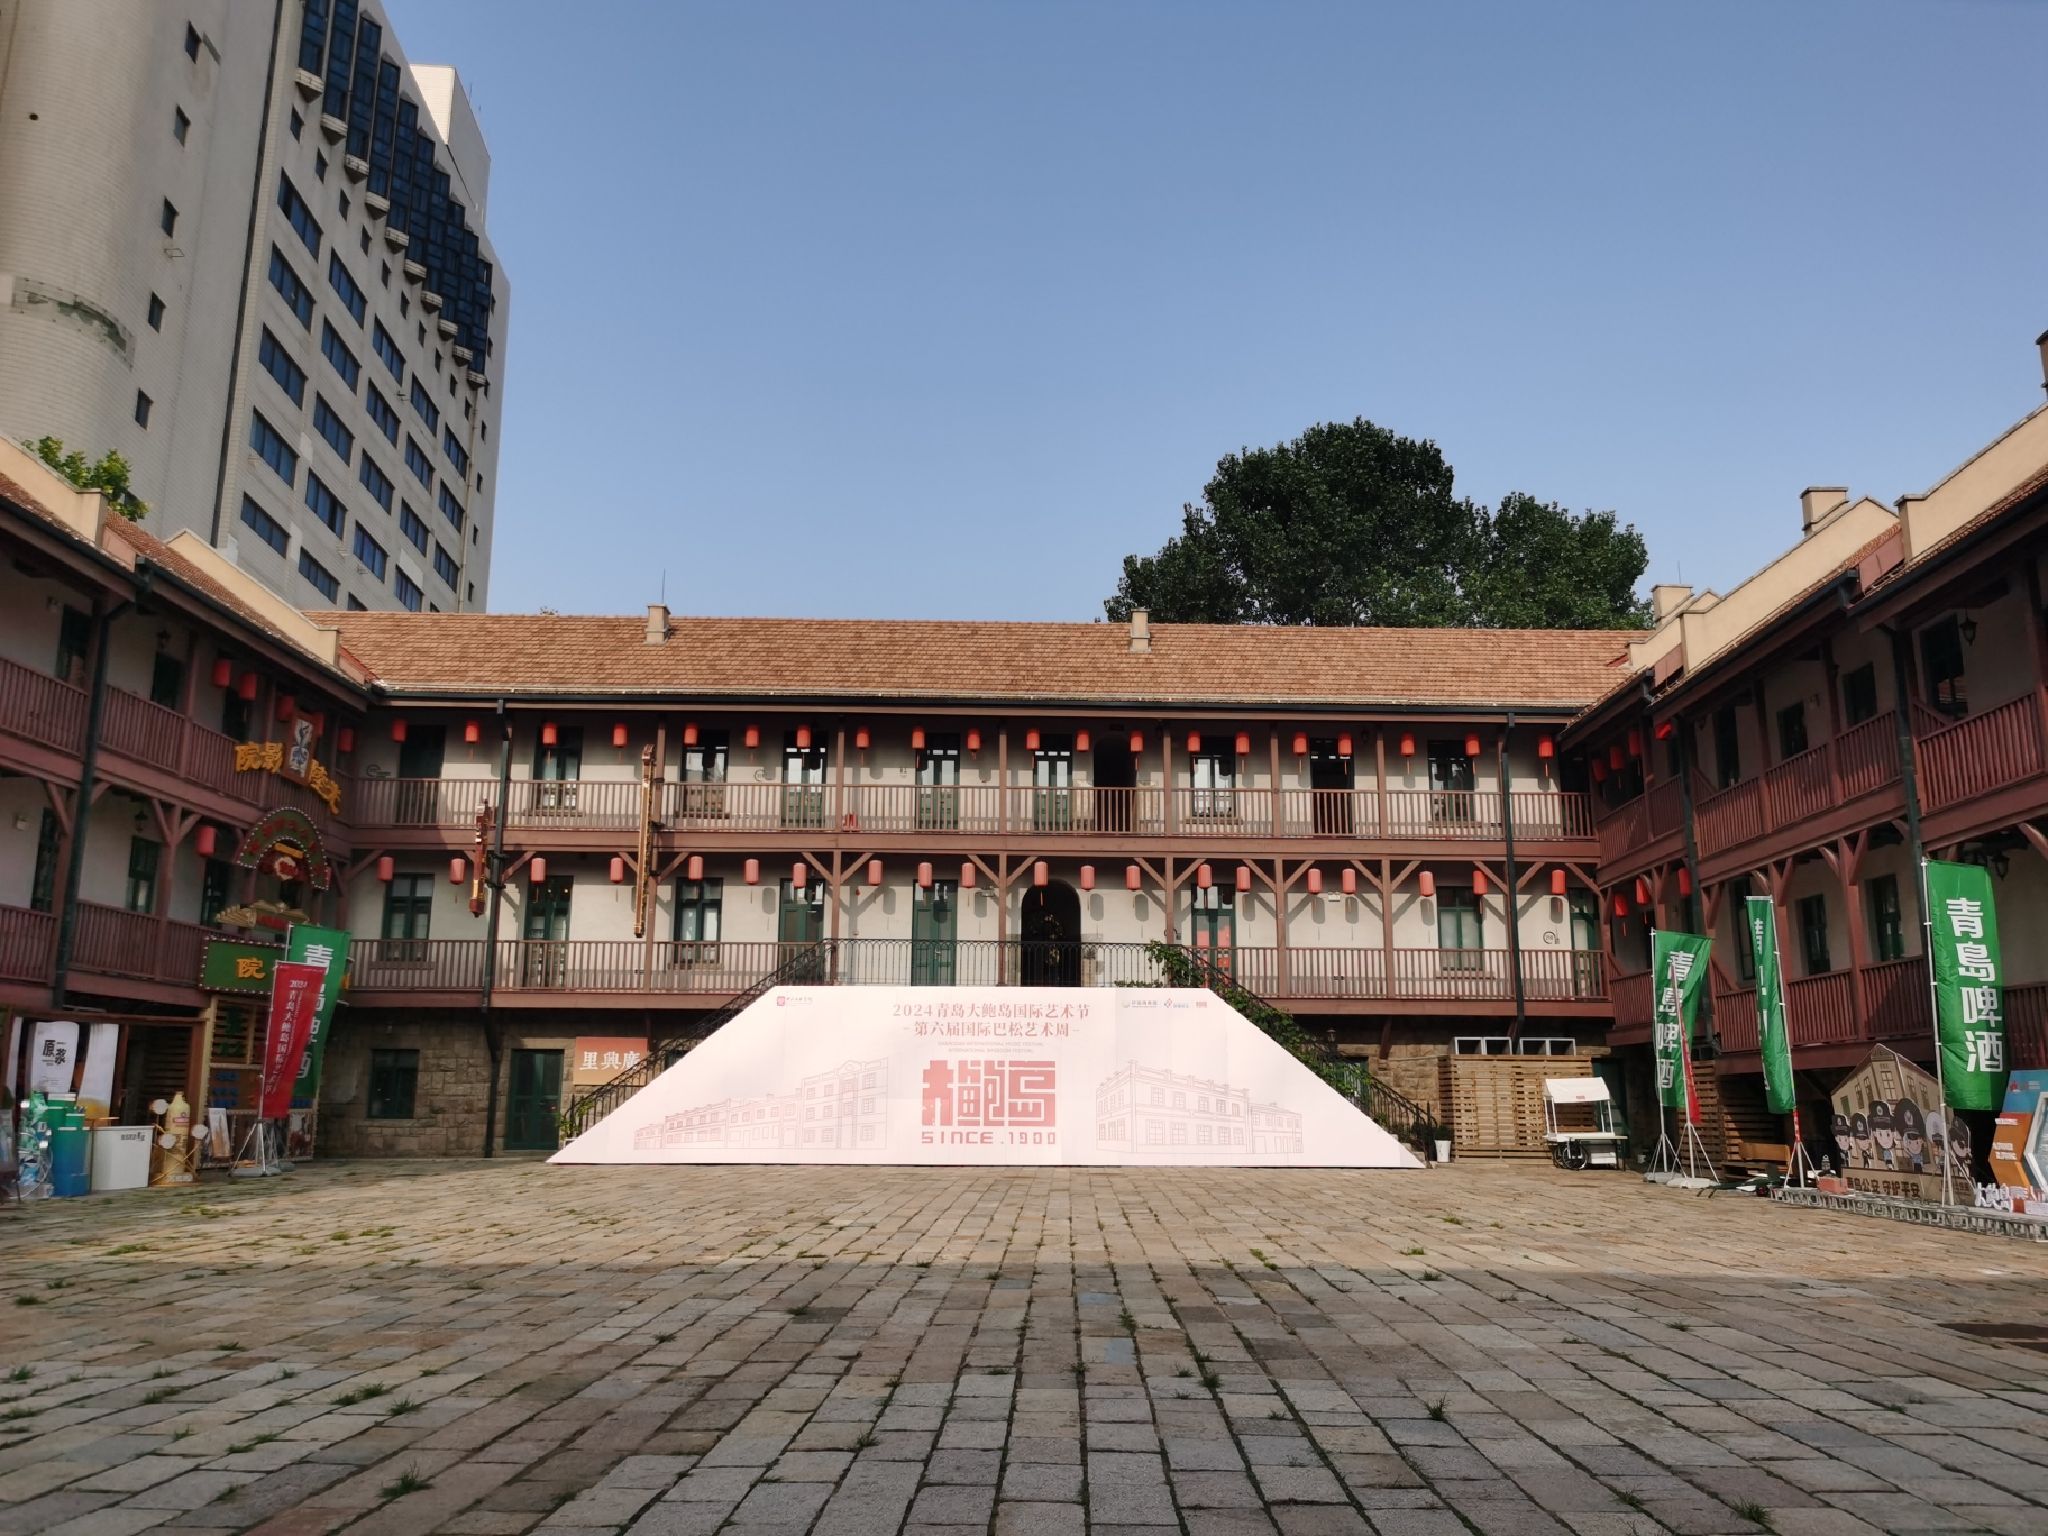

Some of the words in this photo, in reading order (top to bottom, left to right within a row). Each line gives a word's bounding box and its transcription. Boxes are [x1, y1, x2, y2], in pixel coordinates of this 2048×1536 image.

[236, 957, 266, 981] 院
[1946, 897, 2003, 1072] 青岛啤酒
